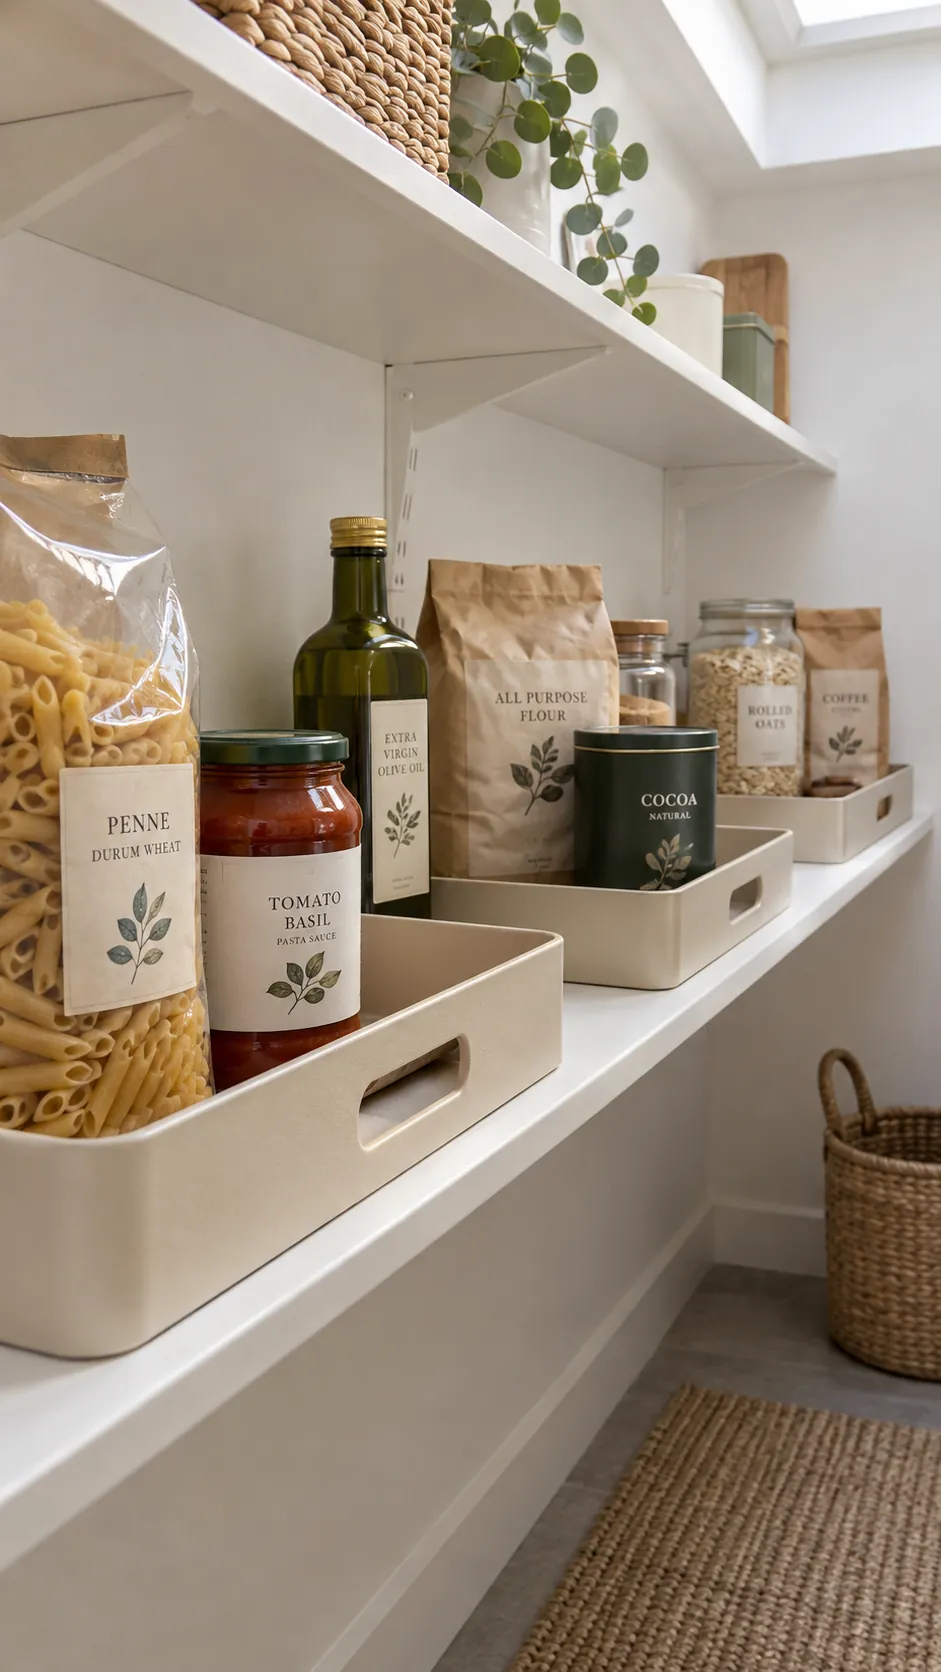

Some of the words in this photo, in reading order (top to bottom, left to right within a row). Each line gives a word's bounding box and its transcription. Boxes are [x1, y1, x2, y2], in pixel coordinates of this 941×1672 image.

[495, 692, 522, 704] ALL
[526, 691, 588, 704] PURPOSE
[520, 710, 566, 722] FLOUR
[748, 705, 792, 716] ROLLED
[755, 719, 786, 729] OATS
[385, 732, 417, 744] EXTRA
[384, 747, 418, 760] VIRGIN
[378, 764, 407, 776] OLIVE
[409, 762, 424, 773] OIL
[641, 793, 698, 807] COCOA
[649, 811, 691, 821] NATURAL
[107, 811, 170, 835] PENNE
[91, 844, 140, 862] DURUM
[144, 840, 181, 856] WHEAT
[268, 890, 341, 911] TOMATO
[285, 913, 331, 930] BASIL
[277, 936, 306, 946] PASTA
[309, 932, 337, 942] SAUCE
